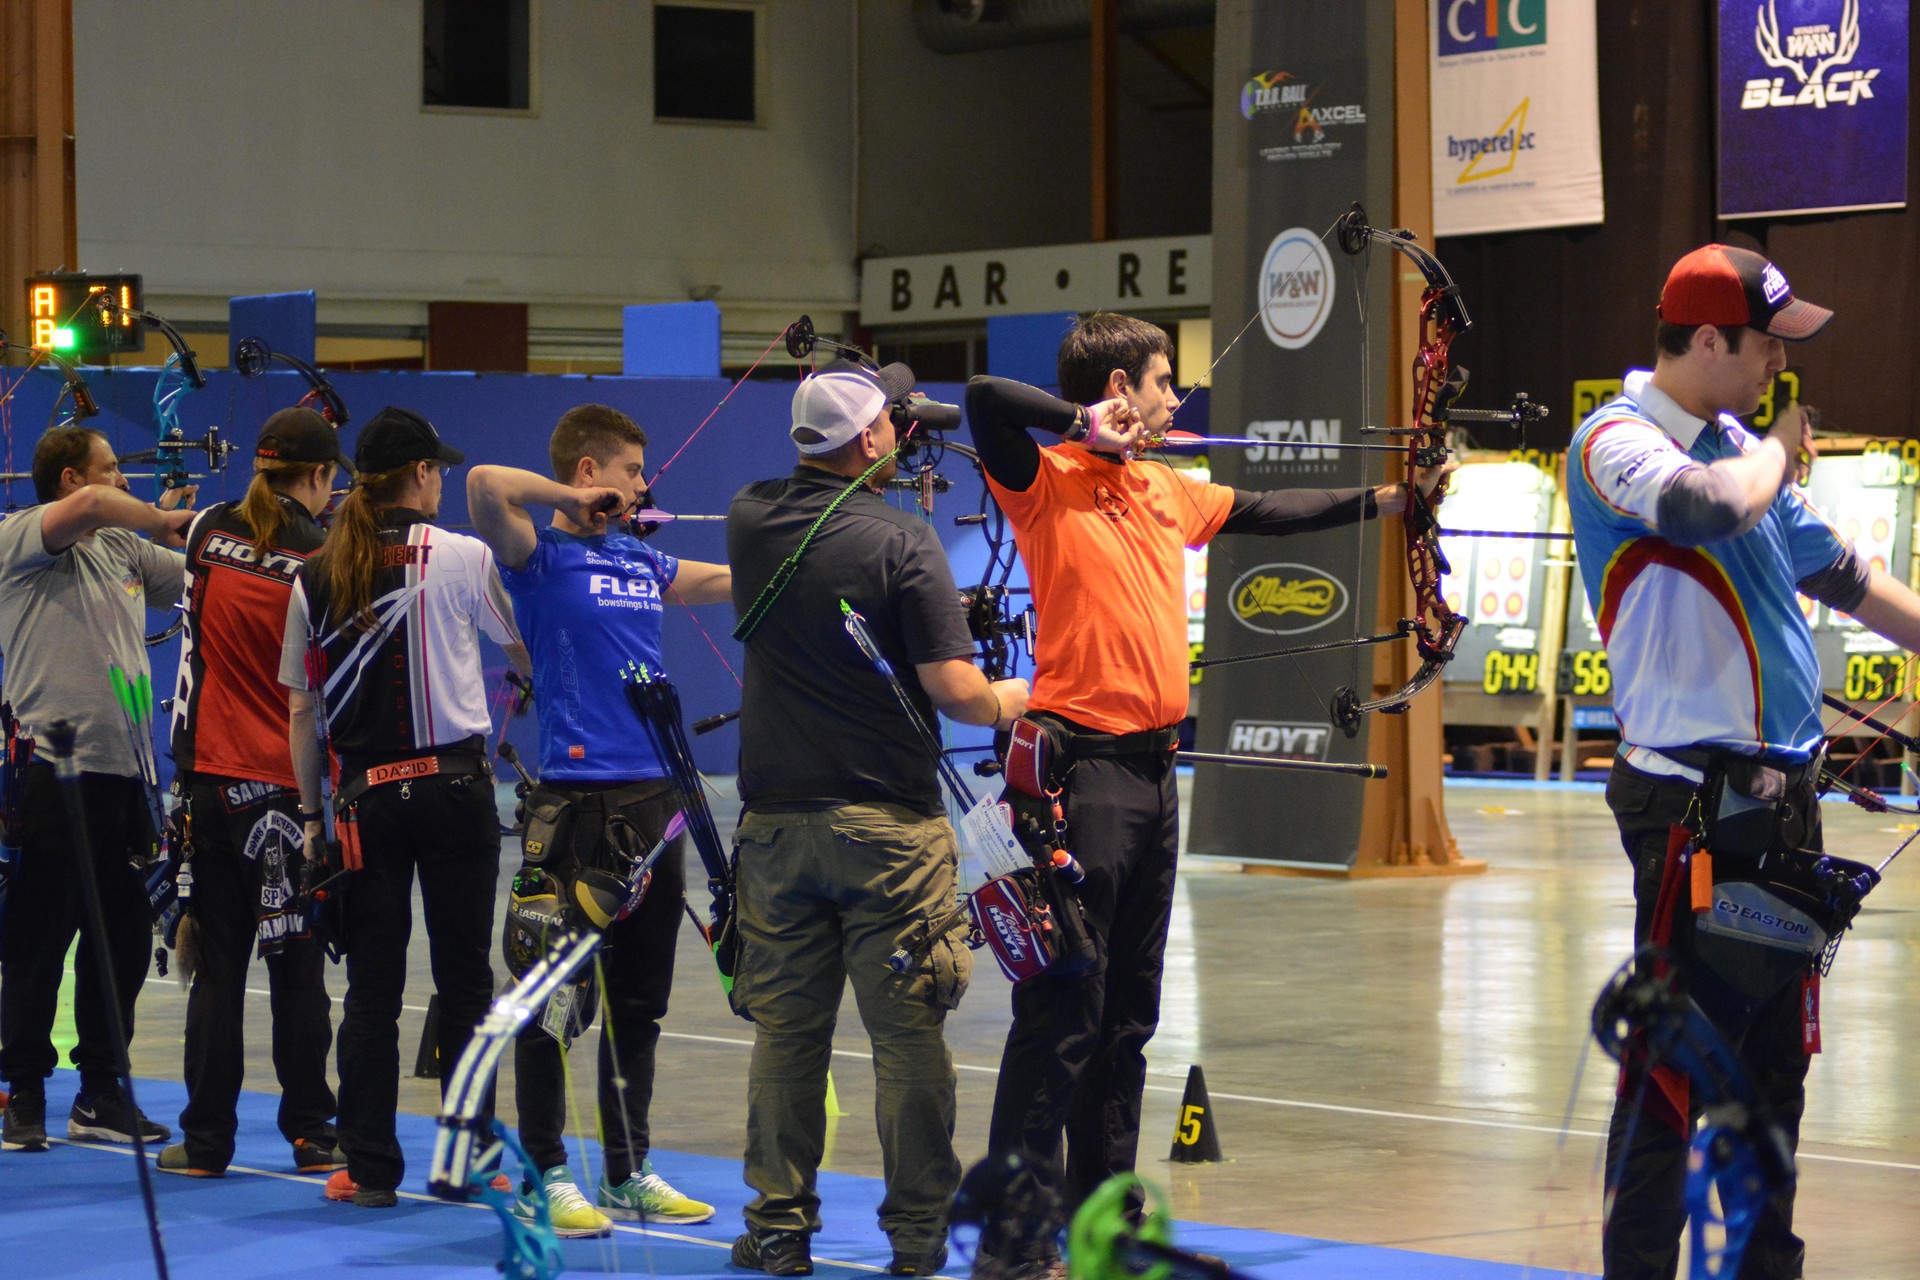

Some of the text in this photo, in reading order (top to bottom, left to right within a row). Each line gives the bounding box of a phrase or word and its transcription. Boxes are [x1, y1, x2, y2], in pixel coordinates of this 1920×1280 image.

[1786, 32, 1837, 58] W&W
[1741, 68, 1881, 109] BLACK
[1448, 129, 1535, 161] hyperelec
[891, 262, 1008, 312] BAR
[1245, 419, 1340, 462] STAN
[206, 537, 304, 575] HOYT
[598, 597, 643, 611] bowstrings
[644, 600, 650, 610] &
[1484, 650, 1905, 701] 044 56 057
[1014, 736, 1035, 750] HOYT
[1231, 725, 1327, 754] HOYT
[376, 761, 428, 781] DAVID
[989, 907, 1024, 959] HOYT
[1741, 906, 1809, 934] EASTON
